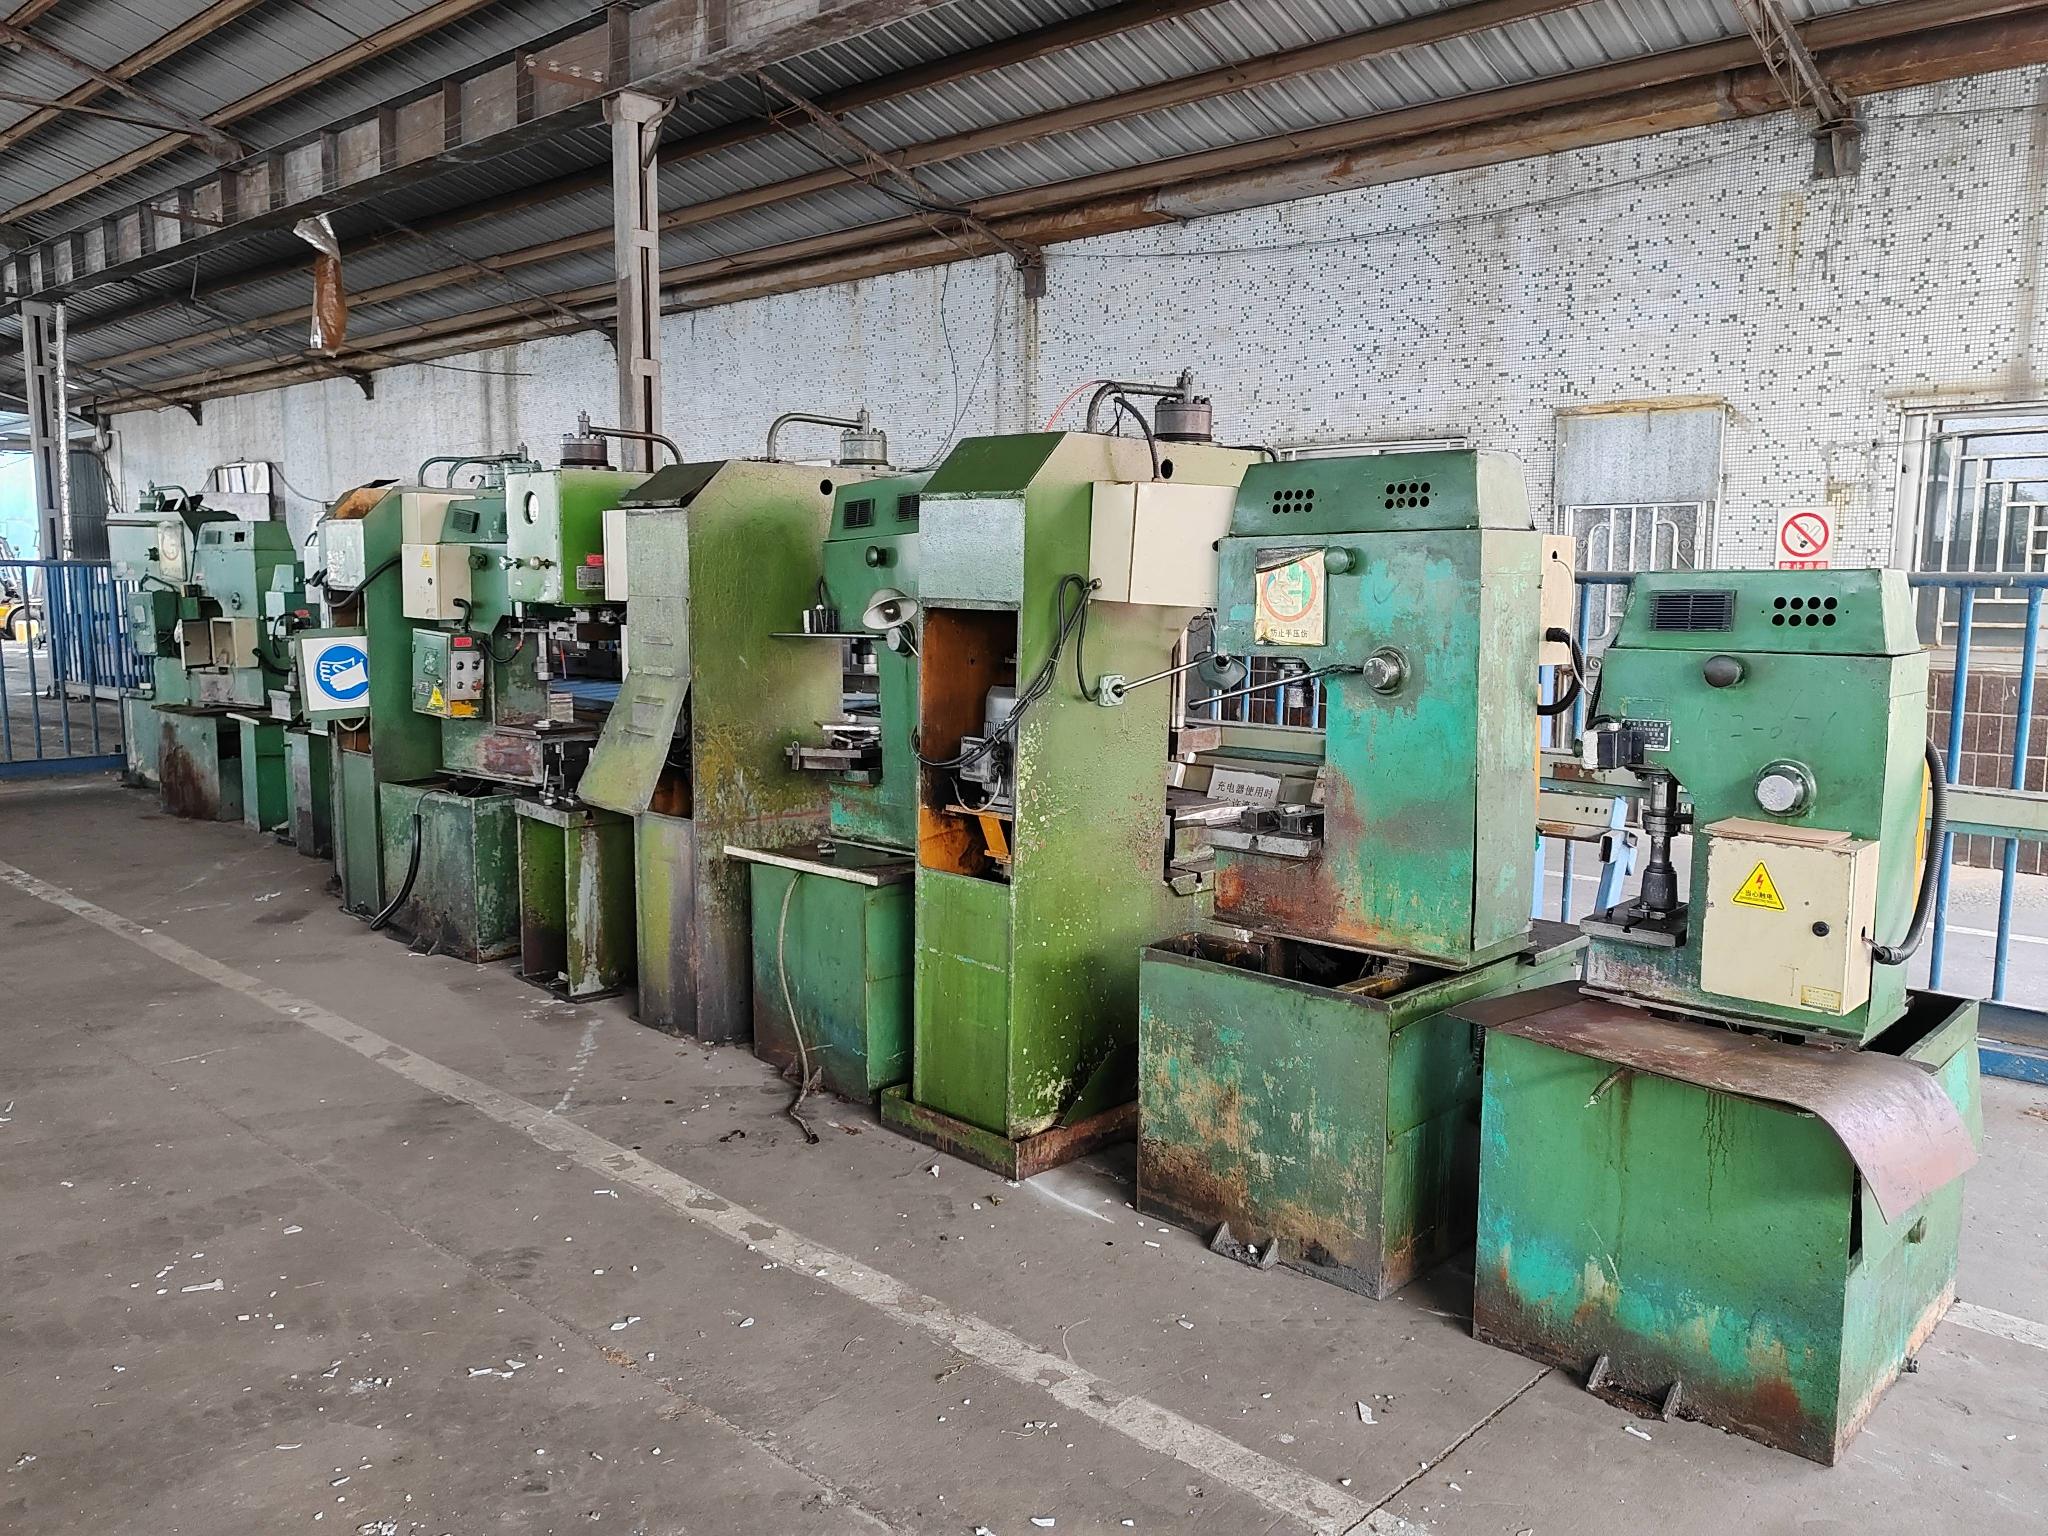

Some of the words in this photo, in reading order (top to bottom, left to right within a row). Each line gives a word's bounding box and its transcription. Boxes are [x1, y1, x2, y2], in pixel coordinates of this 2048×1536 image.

[1216, 781, 1273, 799] 充电器使用时
